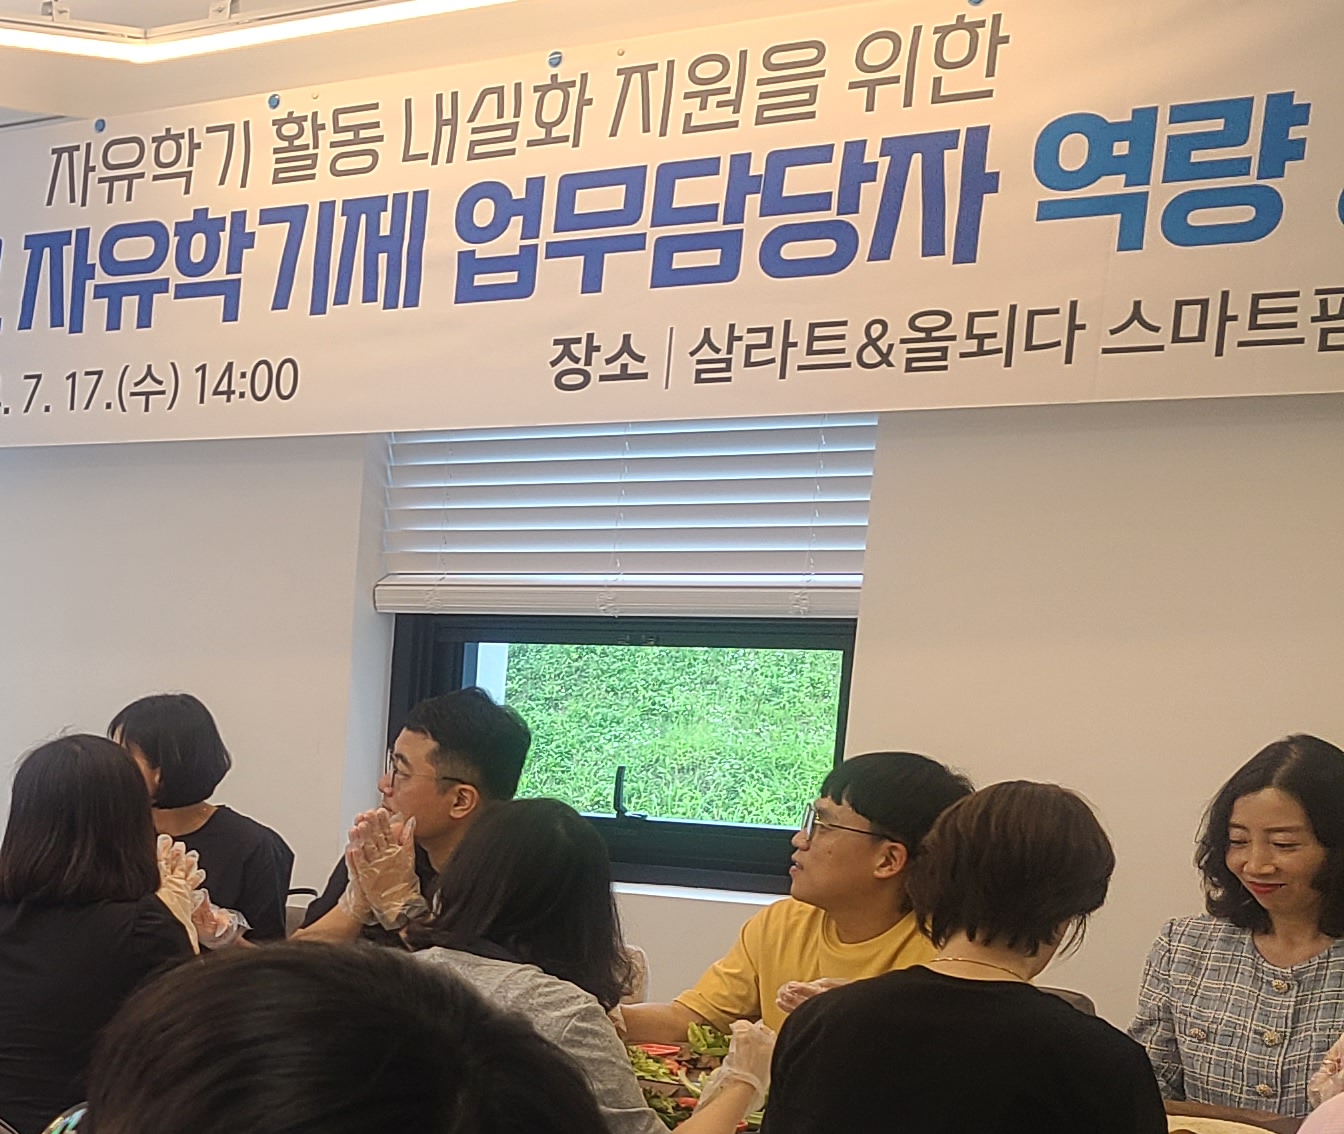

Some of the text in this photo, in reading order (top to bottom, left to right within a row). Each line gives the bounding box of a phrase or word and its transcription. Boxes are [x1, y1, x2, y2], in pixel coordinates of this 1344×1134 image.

[46, 12, 1011, 208] 자유학기 활동 내실화 지원을 위한
[16, 191, 429, 336] 자유학기제
[454, 125, 999, 305] 업무담당자
[1033, 91, 1311, 252] 역량
[22, 376, 52, 415] 7.
[63, 361, 181, 416] 17.(수)
[192, 358, 298, 406] 14:00
[549, 332, 649, 392] 장소
[688, 299, 1087, 384] 살라트&올되다
